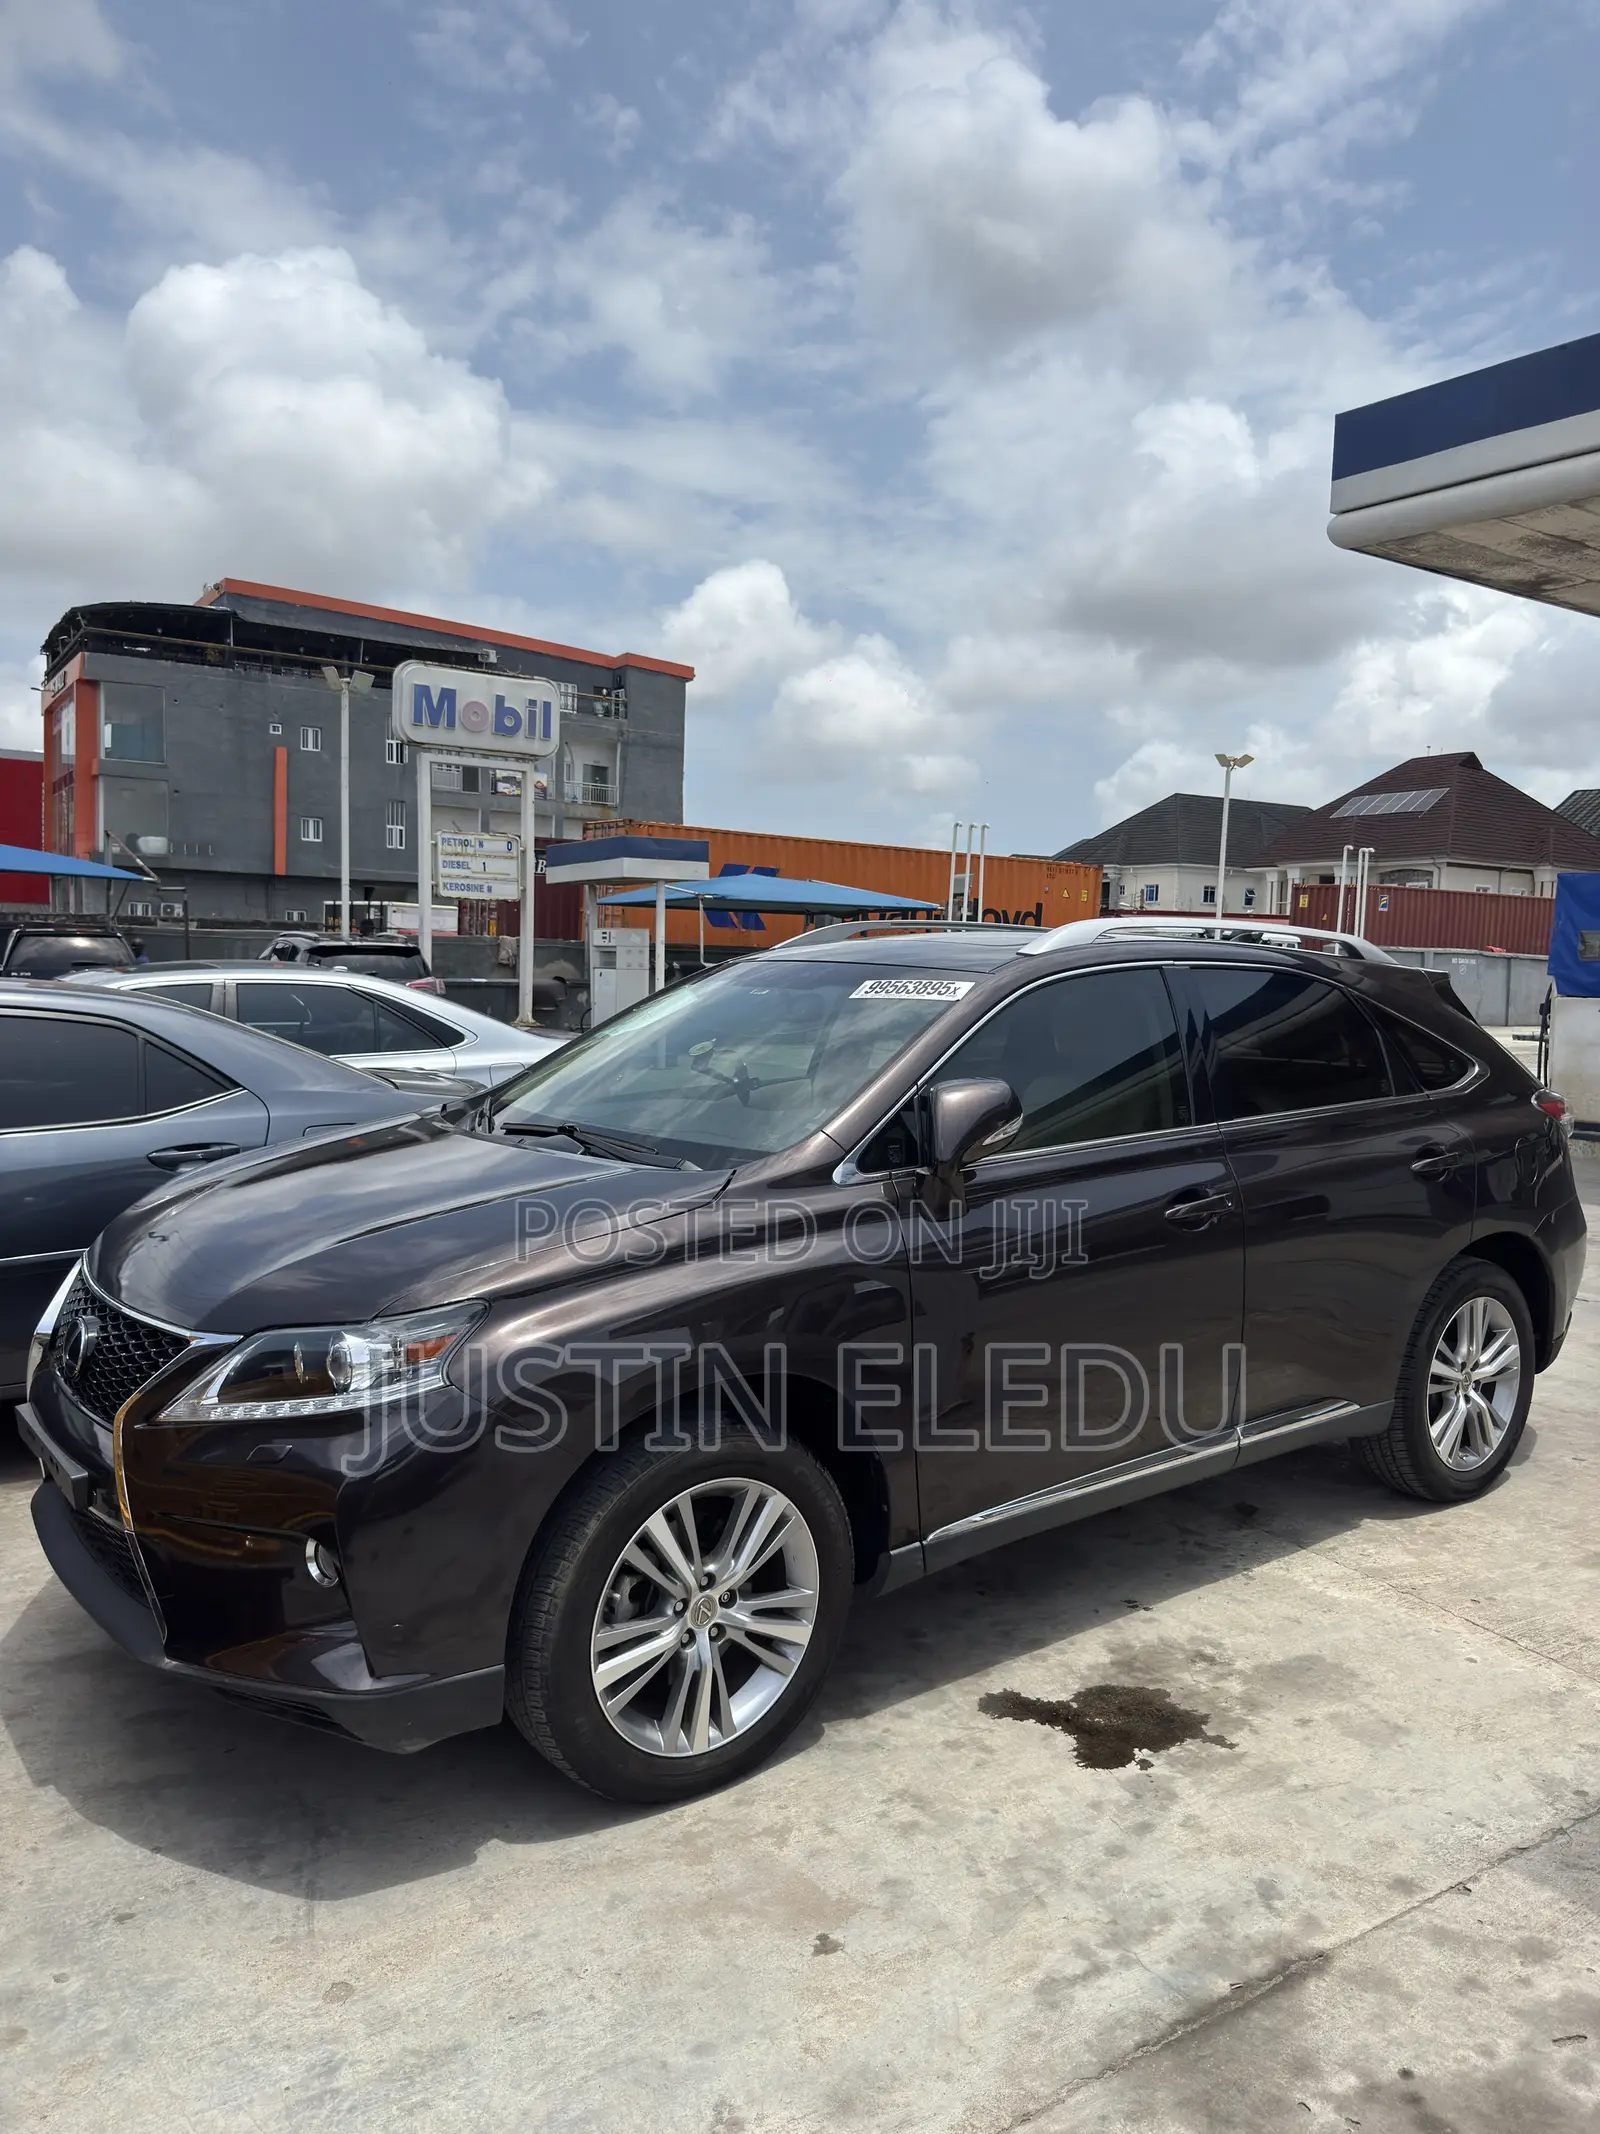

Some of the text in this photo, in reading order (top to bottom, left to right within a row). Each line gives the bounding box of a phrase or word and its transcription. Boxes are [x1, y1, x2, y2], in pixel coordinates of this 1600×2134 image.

[411, 683, 552, 741] Mobil
[441, 837, 475, 848] PETROL
[506, 840, 513, 852] 0
[442, 860, 487, 872] DIESEL 1
[443, 882, 484, 893] KEROSINE
